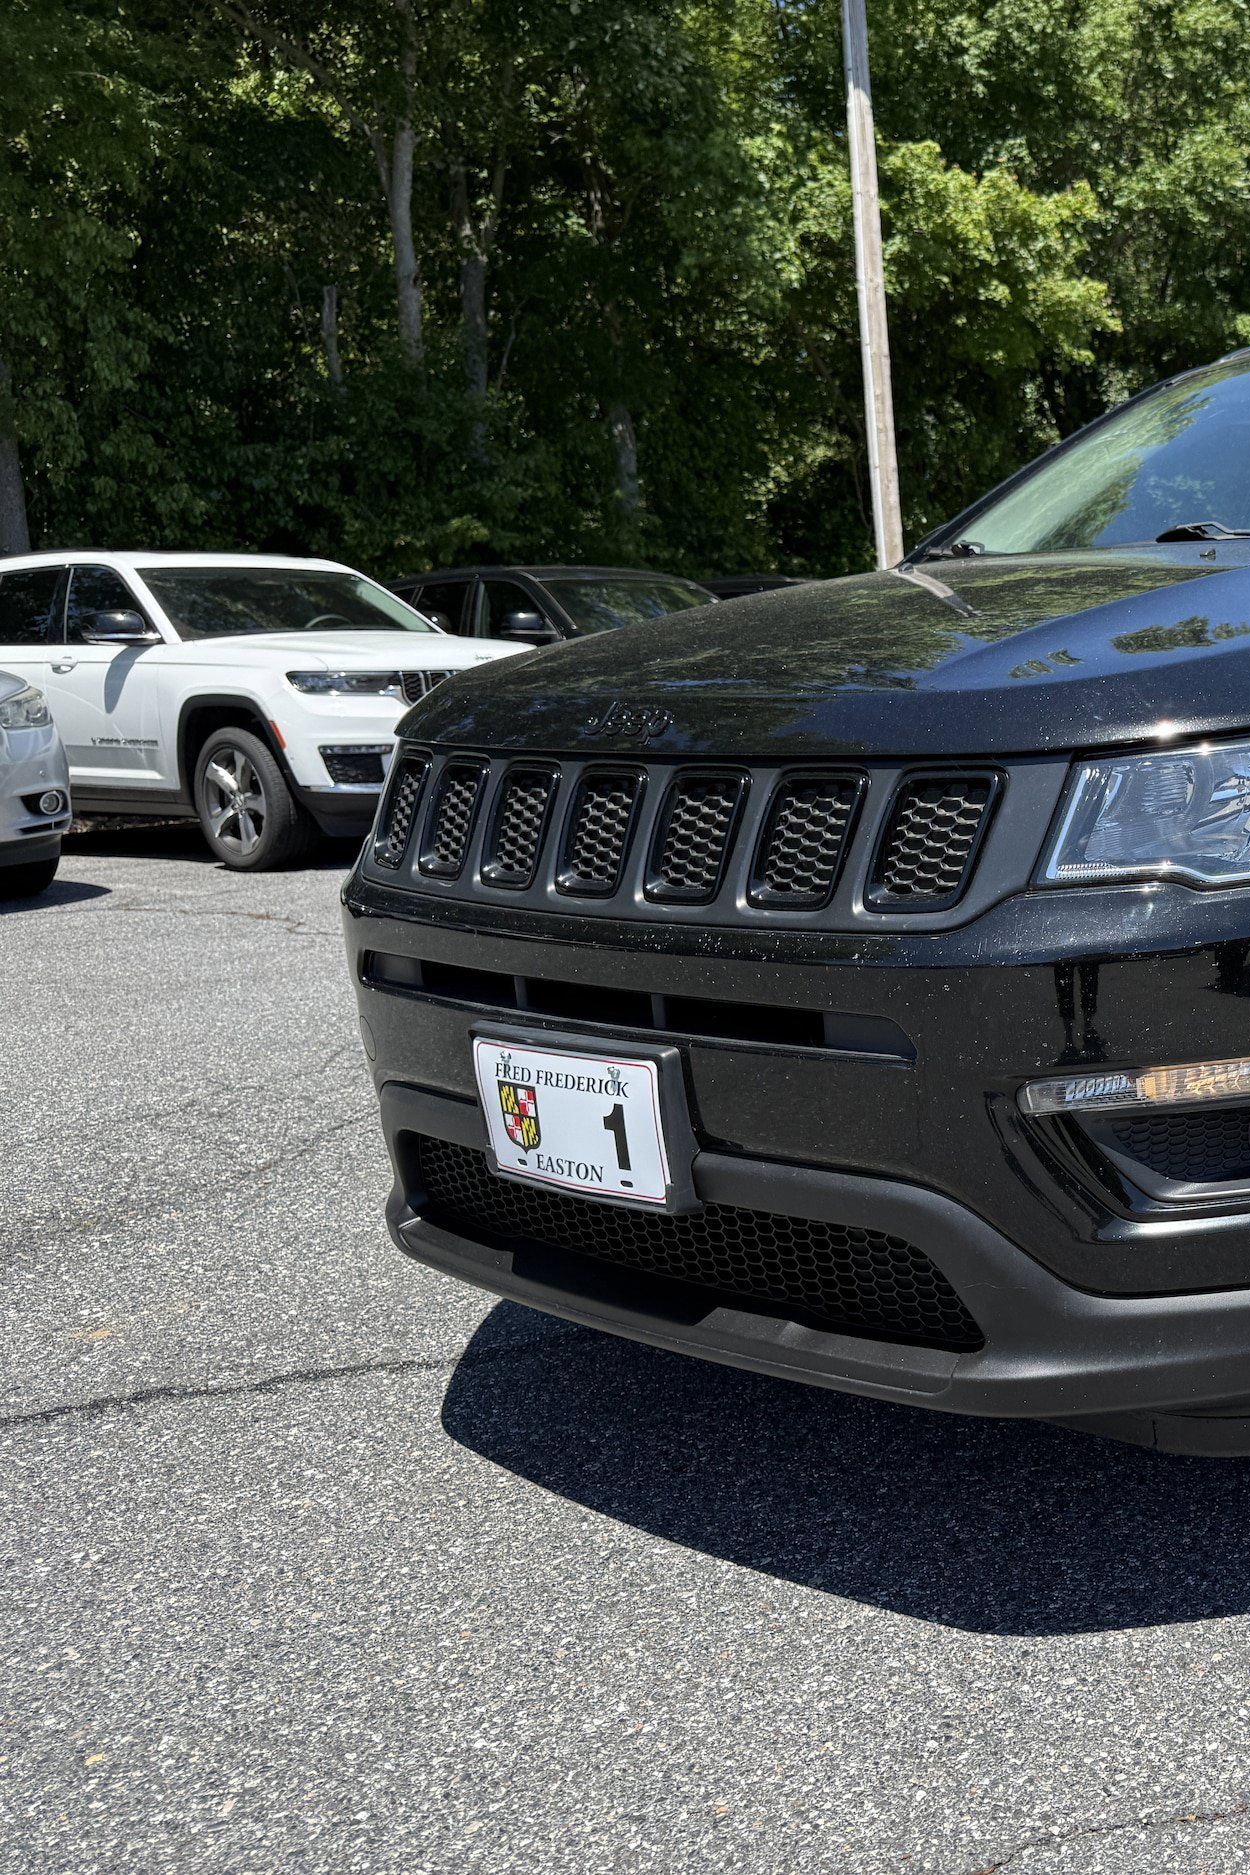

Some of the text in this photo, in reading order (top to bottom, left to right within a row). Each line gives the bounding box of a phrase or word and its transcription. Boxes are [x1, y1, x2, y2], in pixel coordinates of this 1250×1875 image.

[583, 701, 673, 746] Jeep
[495, 1062, 630, 1099] FRED FREDERICK
[602, 1103, 632, 1172] 1
[535, 1153, 604, 1183] EASTON
